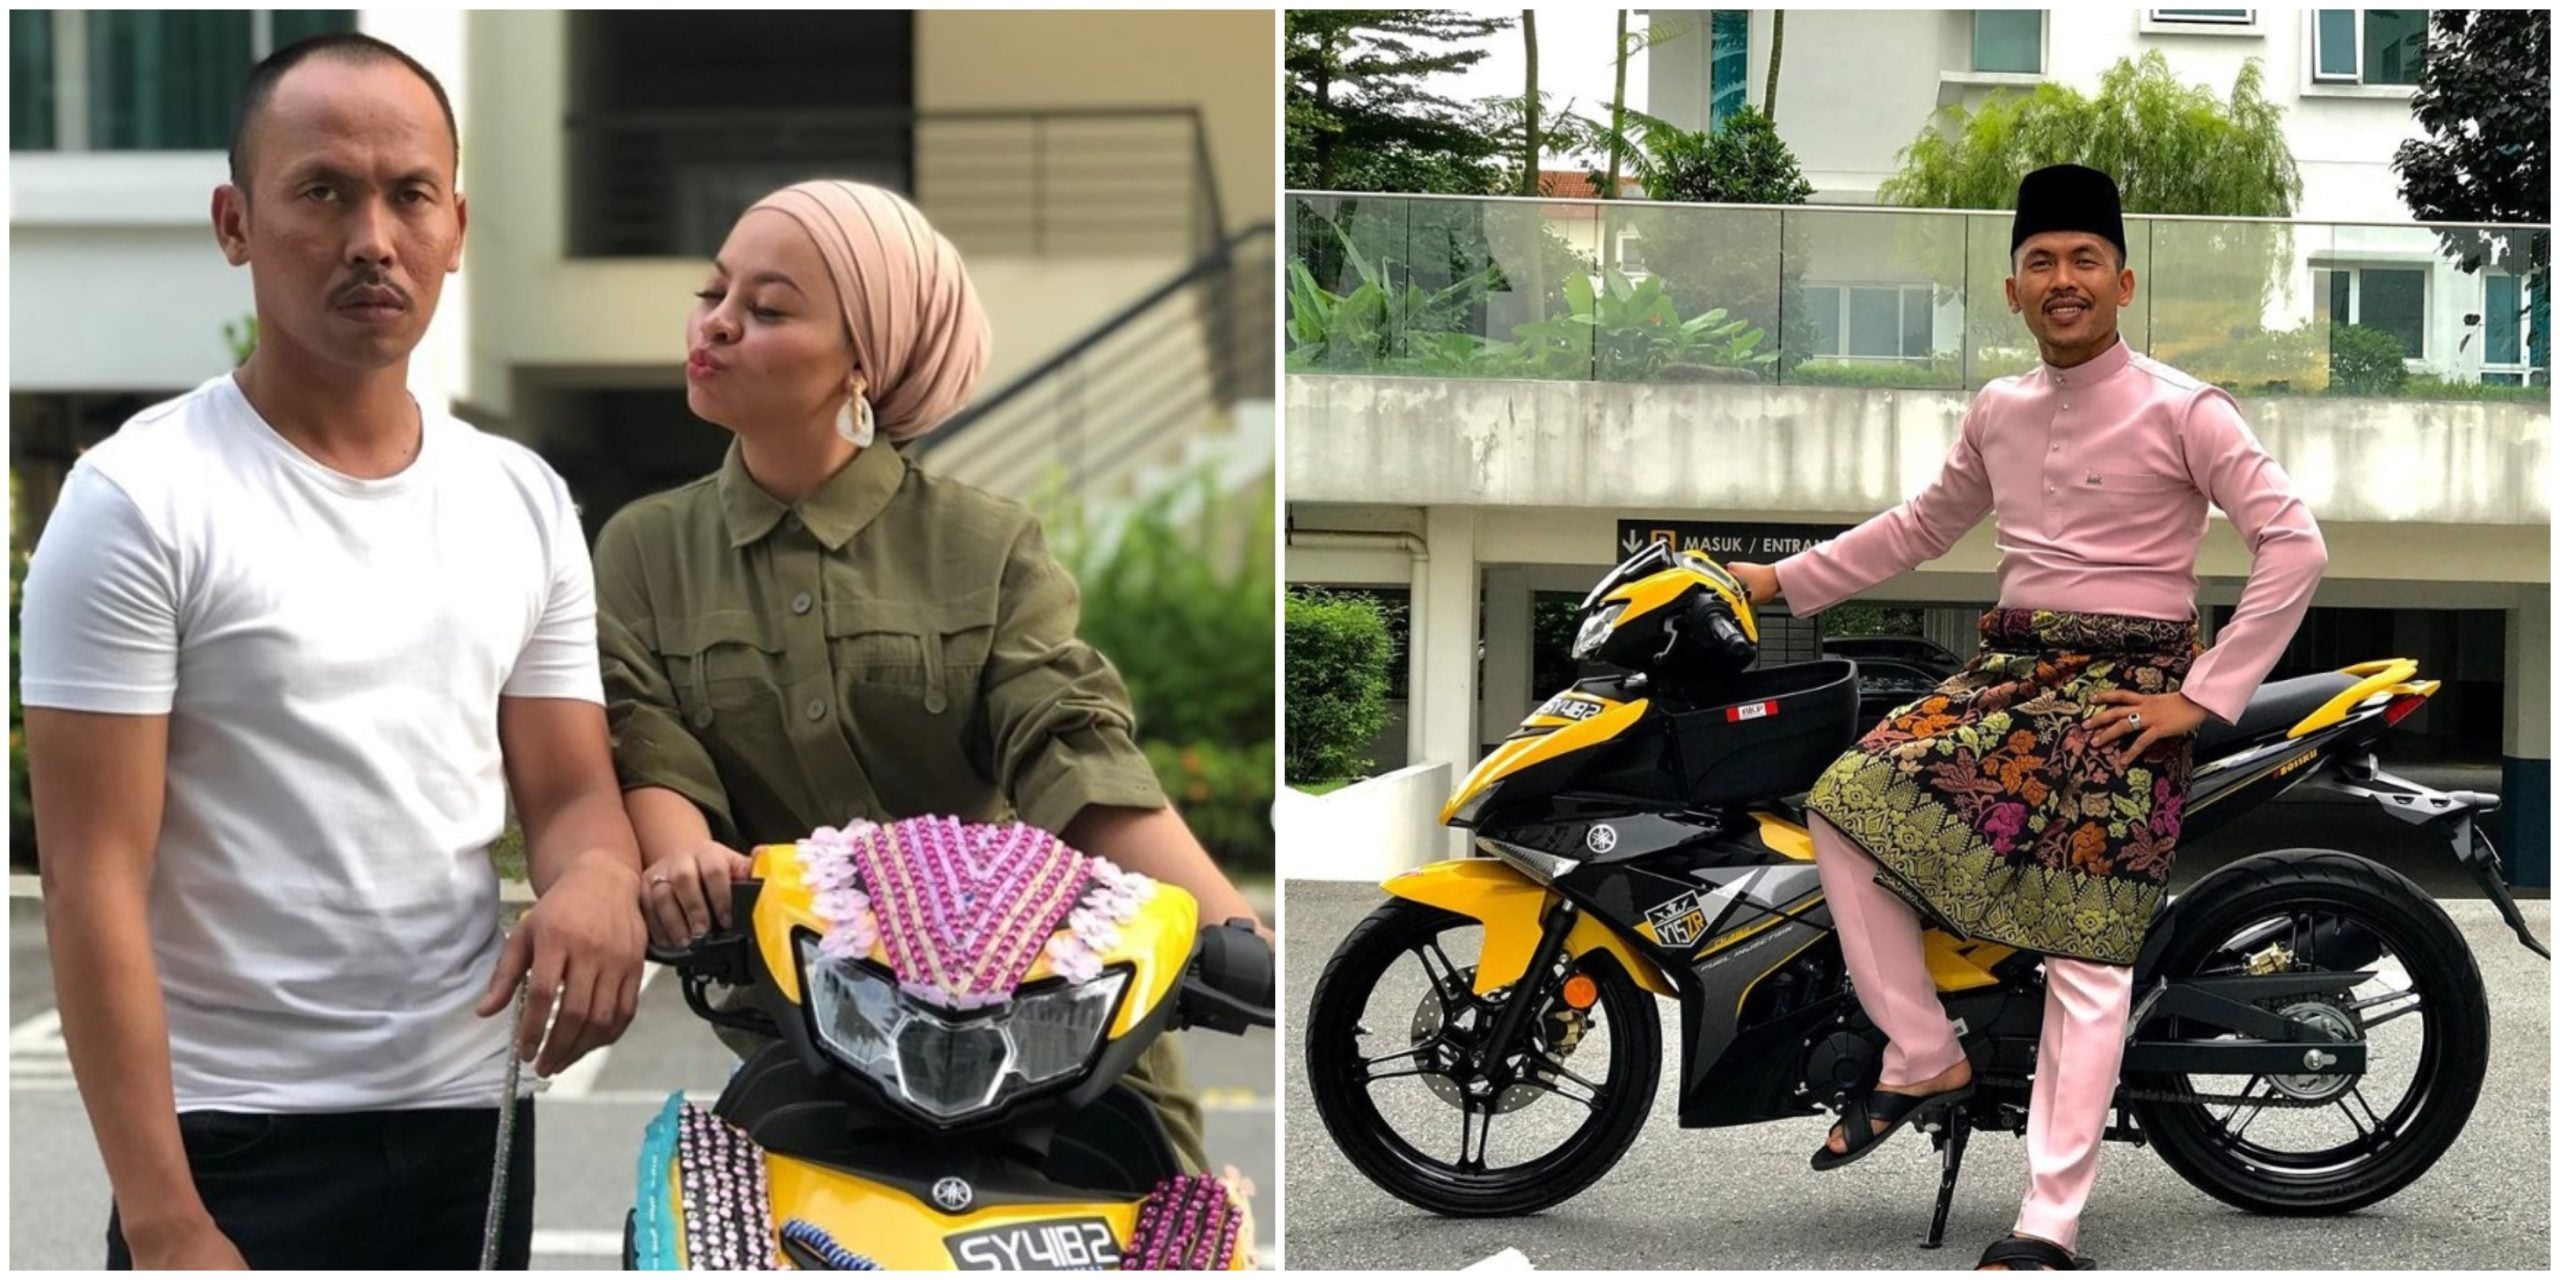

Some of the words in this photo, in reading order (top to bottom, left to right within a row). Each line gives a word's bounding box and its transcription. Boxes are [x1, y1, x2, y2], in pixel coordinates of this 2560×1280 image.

[1684, 536, 1742, 552] MASUK
[1748, 538, 1757, 554] /
[1656, 910, 1705, 944] Y15ZR
